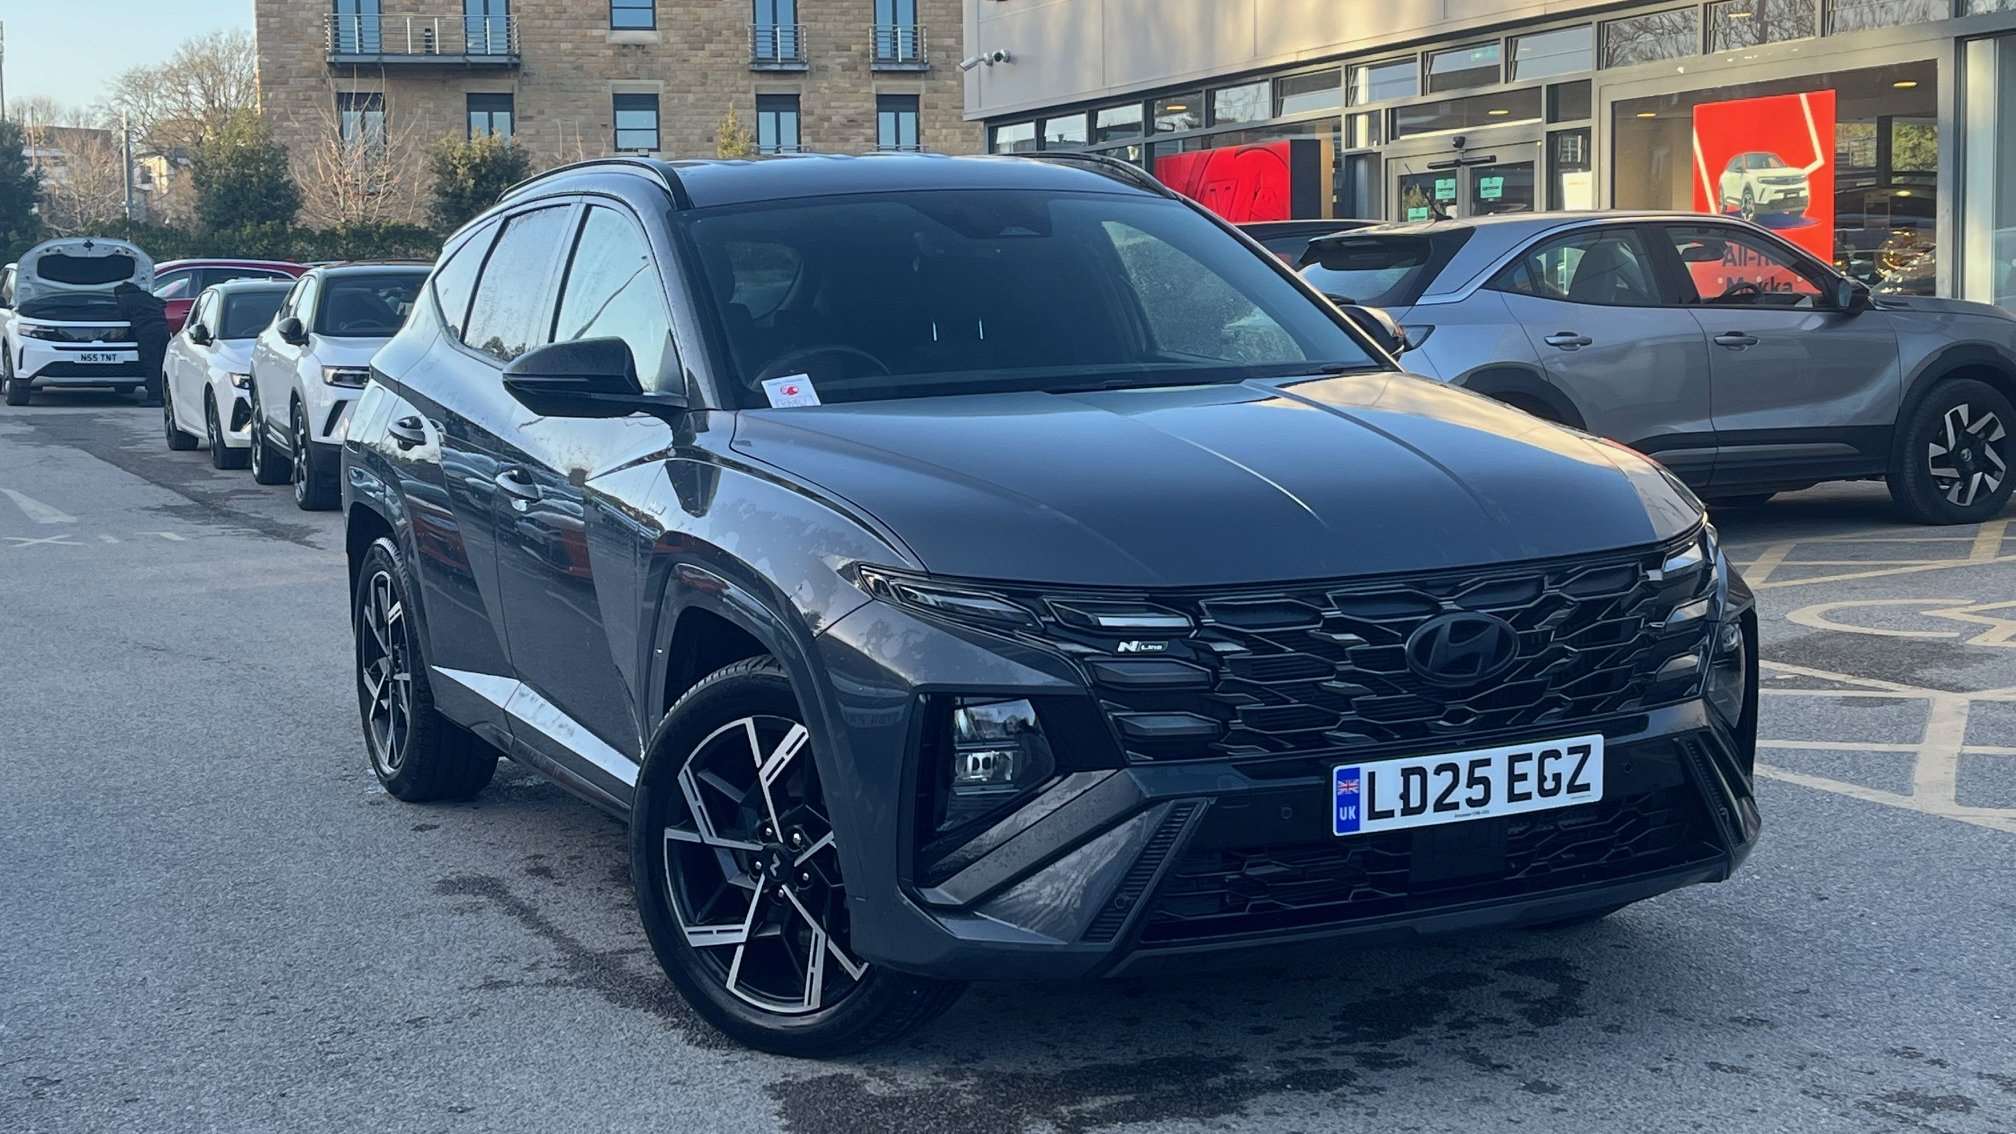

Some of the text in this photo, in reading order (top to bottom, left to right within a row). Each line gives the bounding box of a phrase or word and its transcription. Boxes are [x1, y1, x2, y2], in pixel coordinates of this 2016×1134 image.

[1727, 275, 1792, 293] Mkka
[100, 353, 117, 361] TNT
[1367, 744, 1592, 821] LD25 EGZ
[1339, 805, 1356, 821] UK
